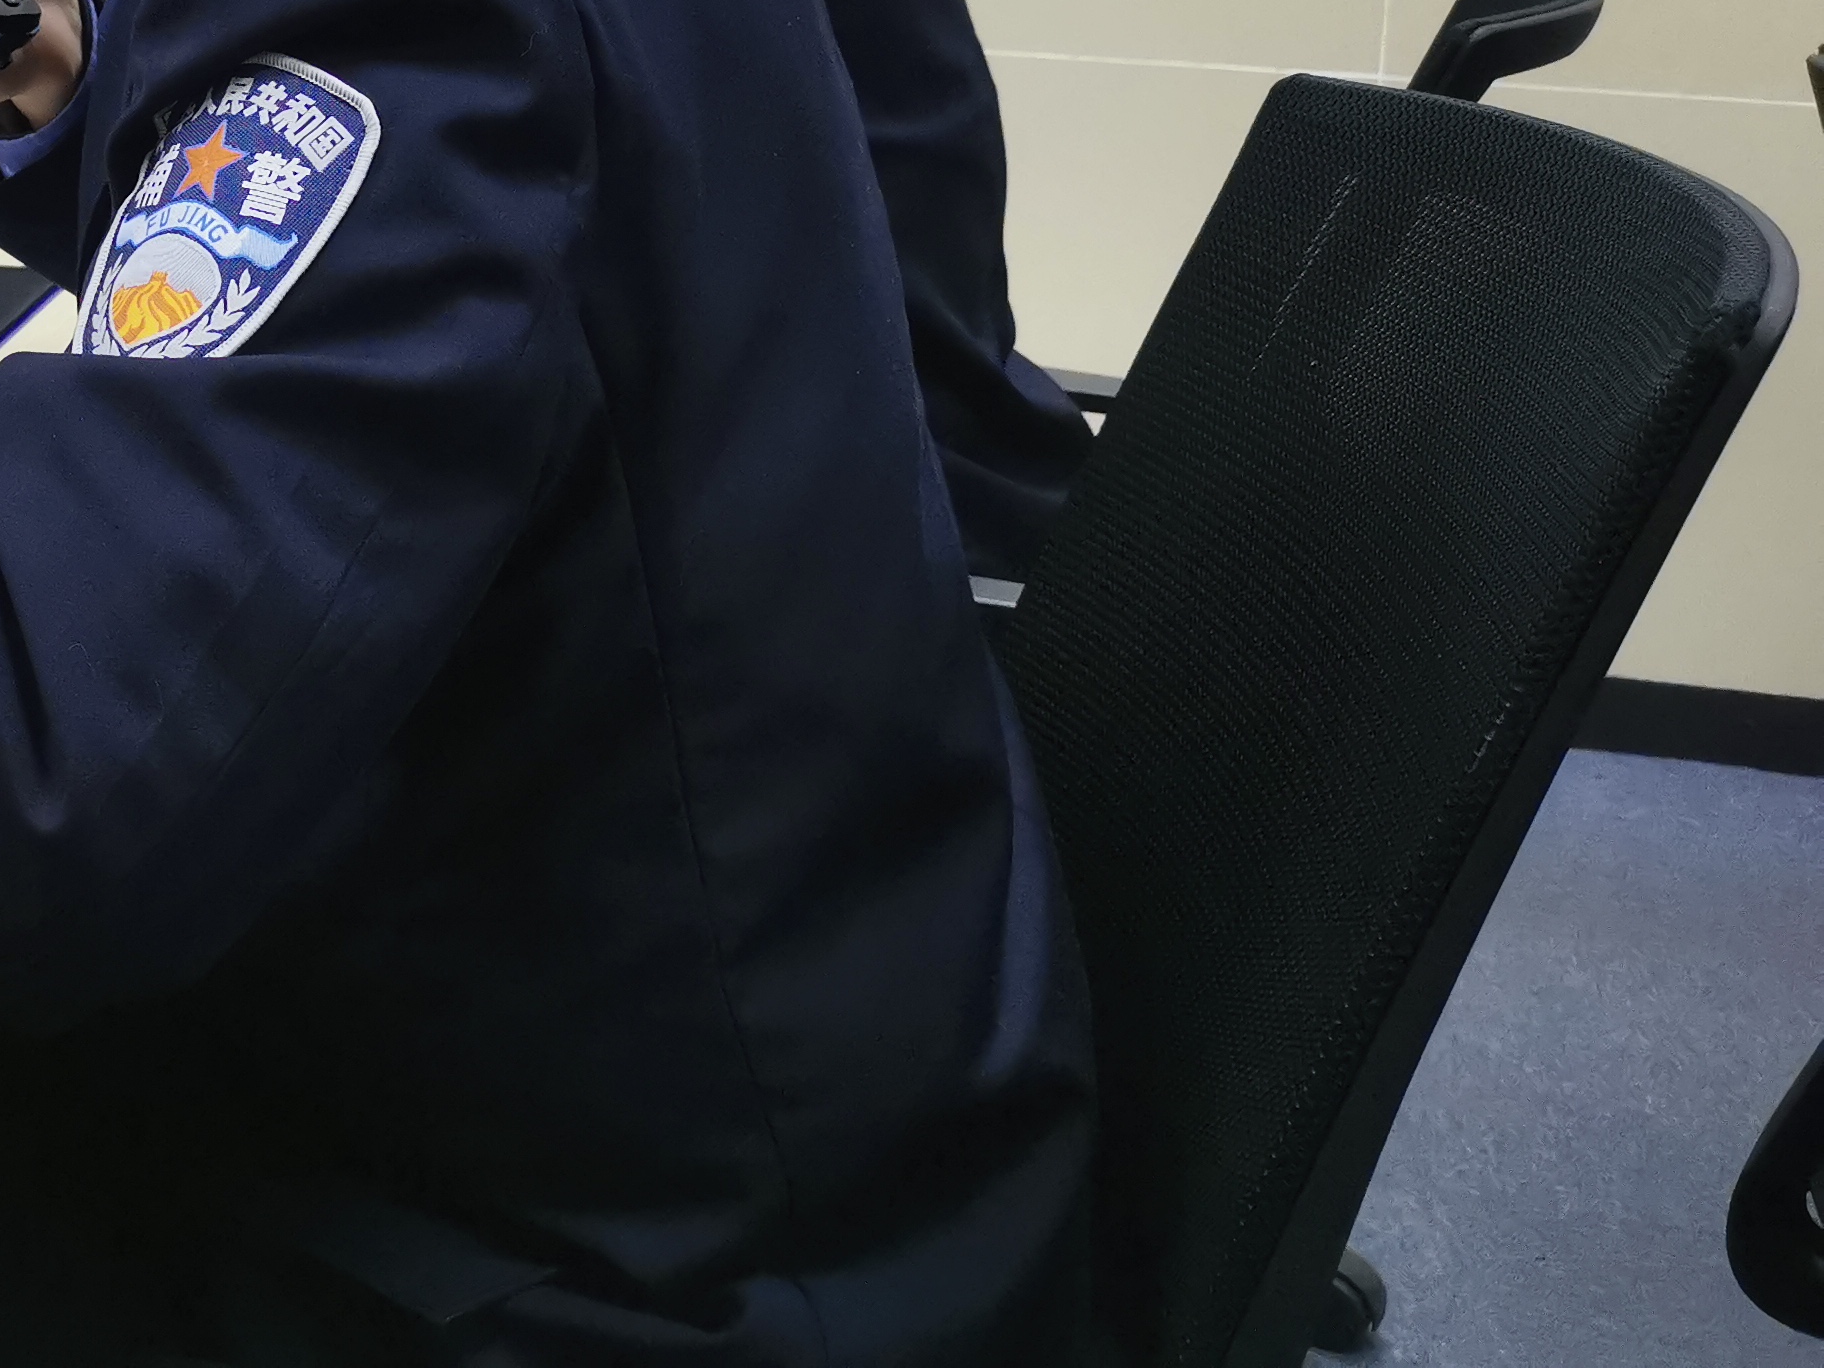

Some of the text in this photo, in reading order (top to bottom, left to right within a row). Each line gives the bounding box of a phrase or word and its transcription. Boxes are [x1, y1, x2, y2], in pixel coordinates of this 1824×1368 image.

[156, 77, 355, 173] 人民共和国
[145, 205, 229, 244] FU JING
